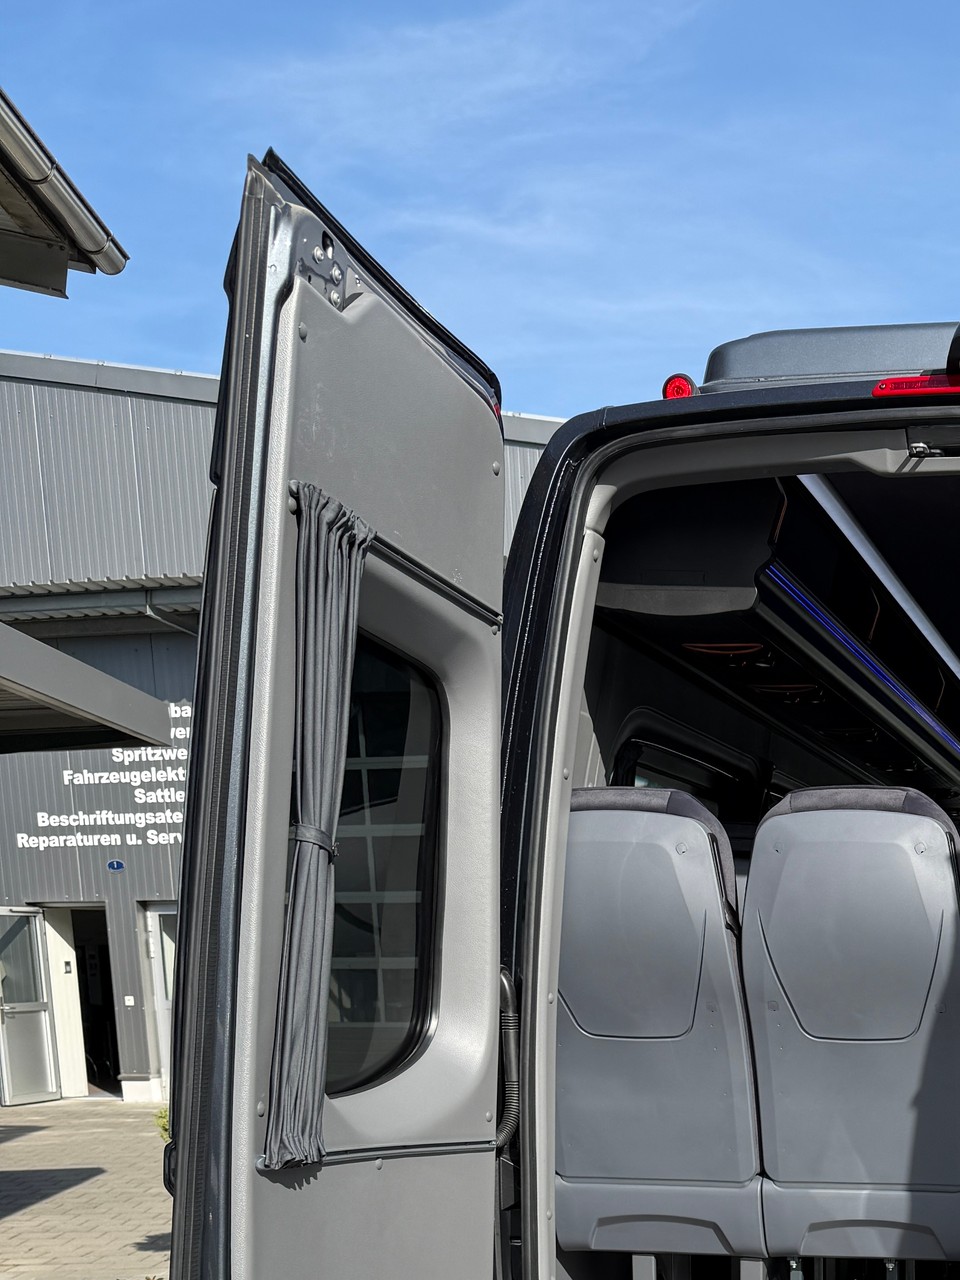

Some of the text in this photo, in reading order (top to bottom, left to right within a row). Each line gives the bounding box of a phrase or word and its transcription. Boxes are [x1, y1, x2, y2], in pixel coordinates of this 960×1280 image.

[63, 766, 187, 786] Fahrzeugelekt
[16, 832, 121, 851] Reparaturen
[126, 833, 143, 845] u.
